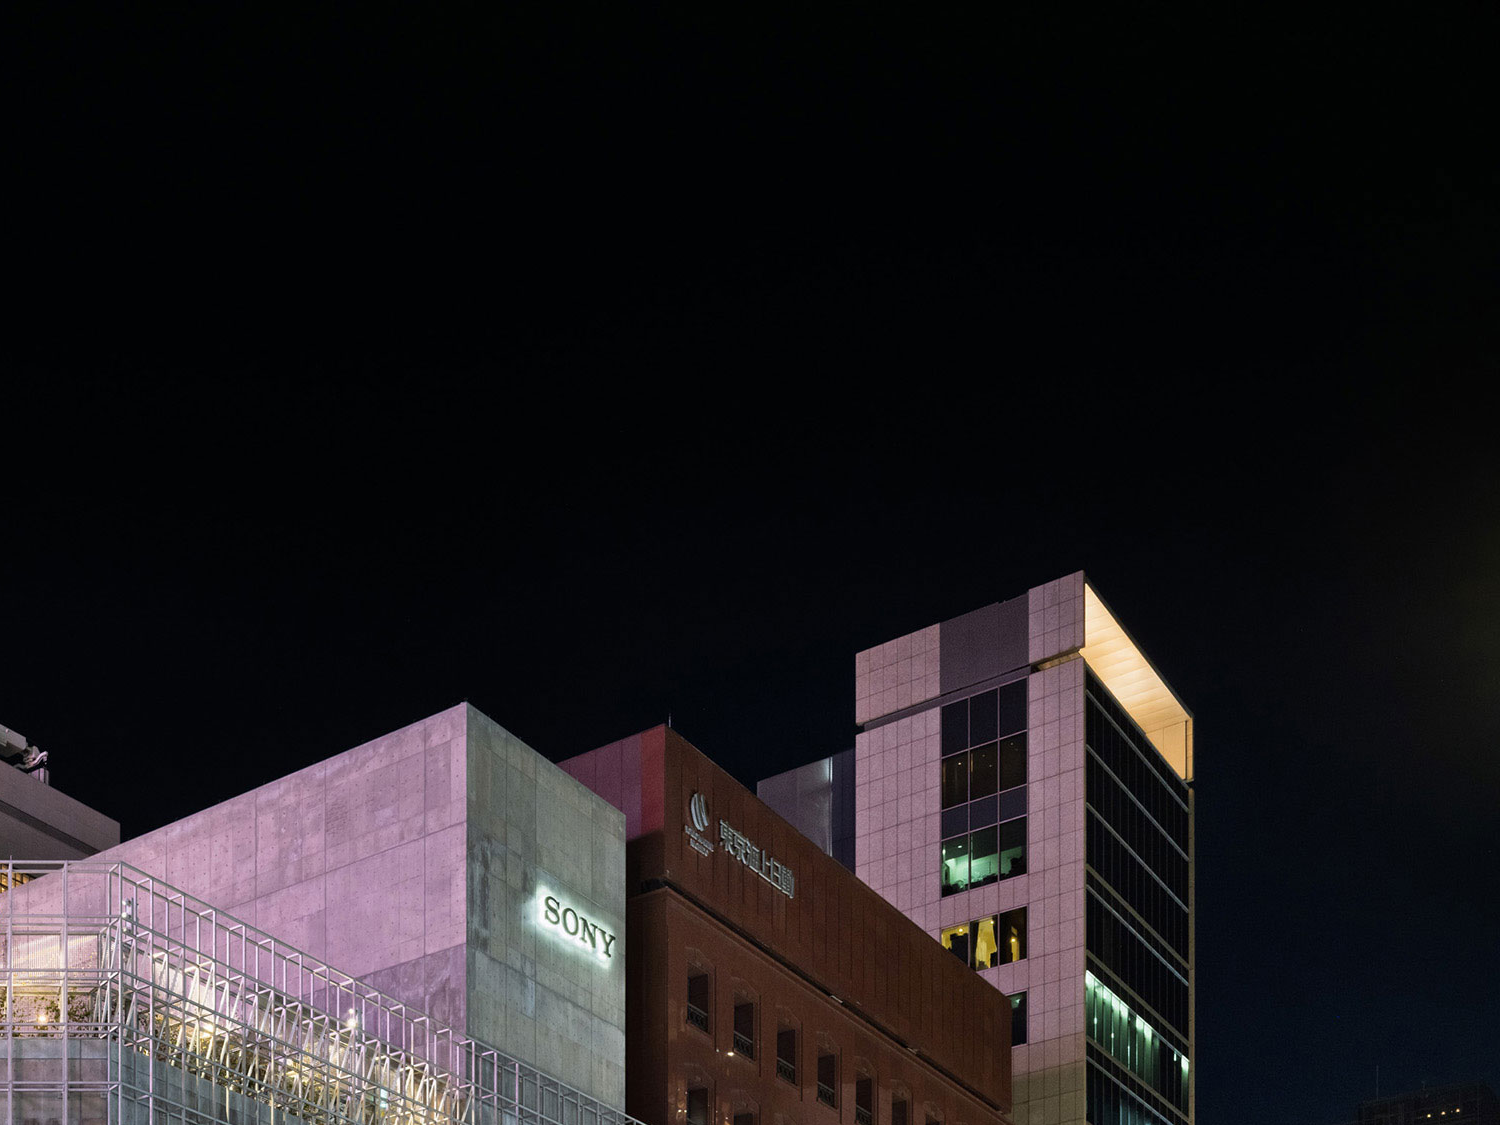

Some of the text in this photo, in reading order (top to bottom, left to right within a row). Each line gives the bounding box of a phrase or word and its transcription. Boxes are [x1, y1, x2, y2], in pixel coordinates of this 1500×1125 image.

[720, 820, 794, 898] 東京海上日動
[544, 896, 616, 958] SONY
